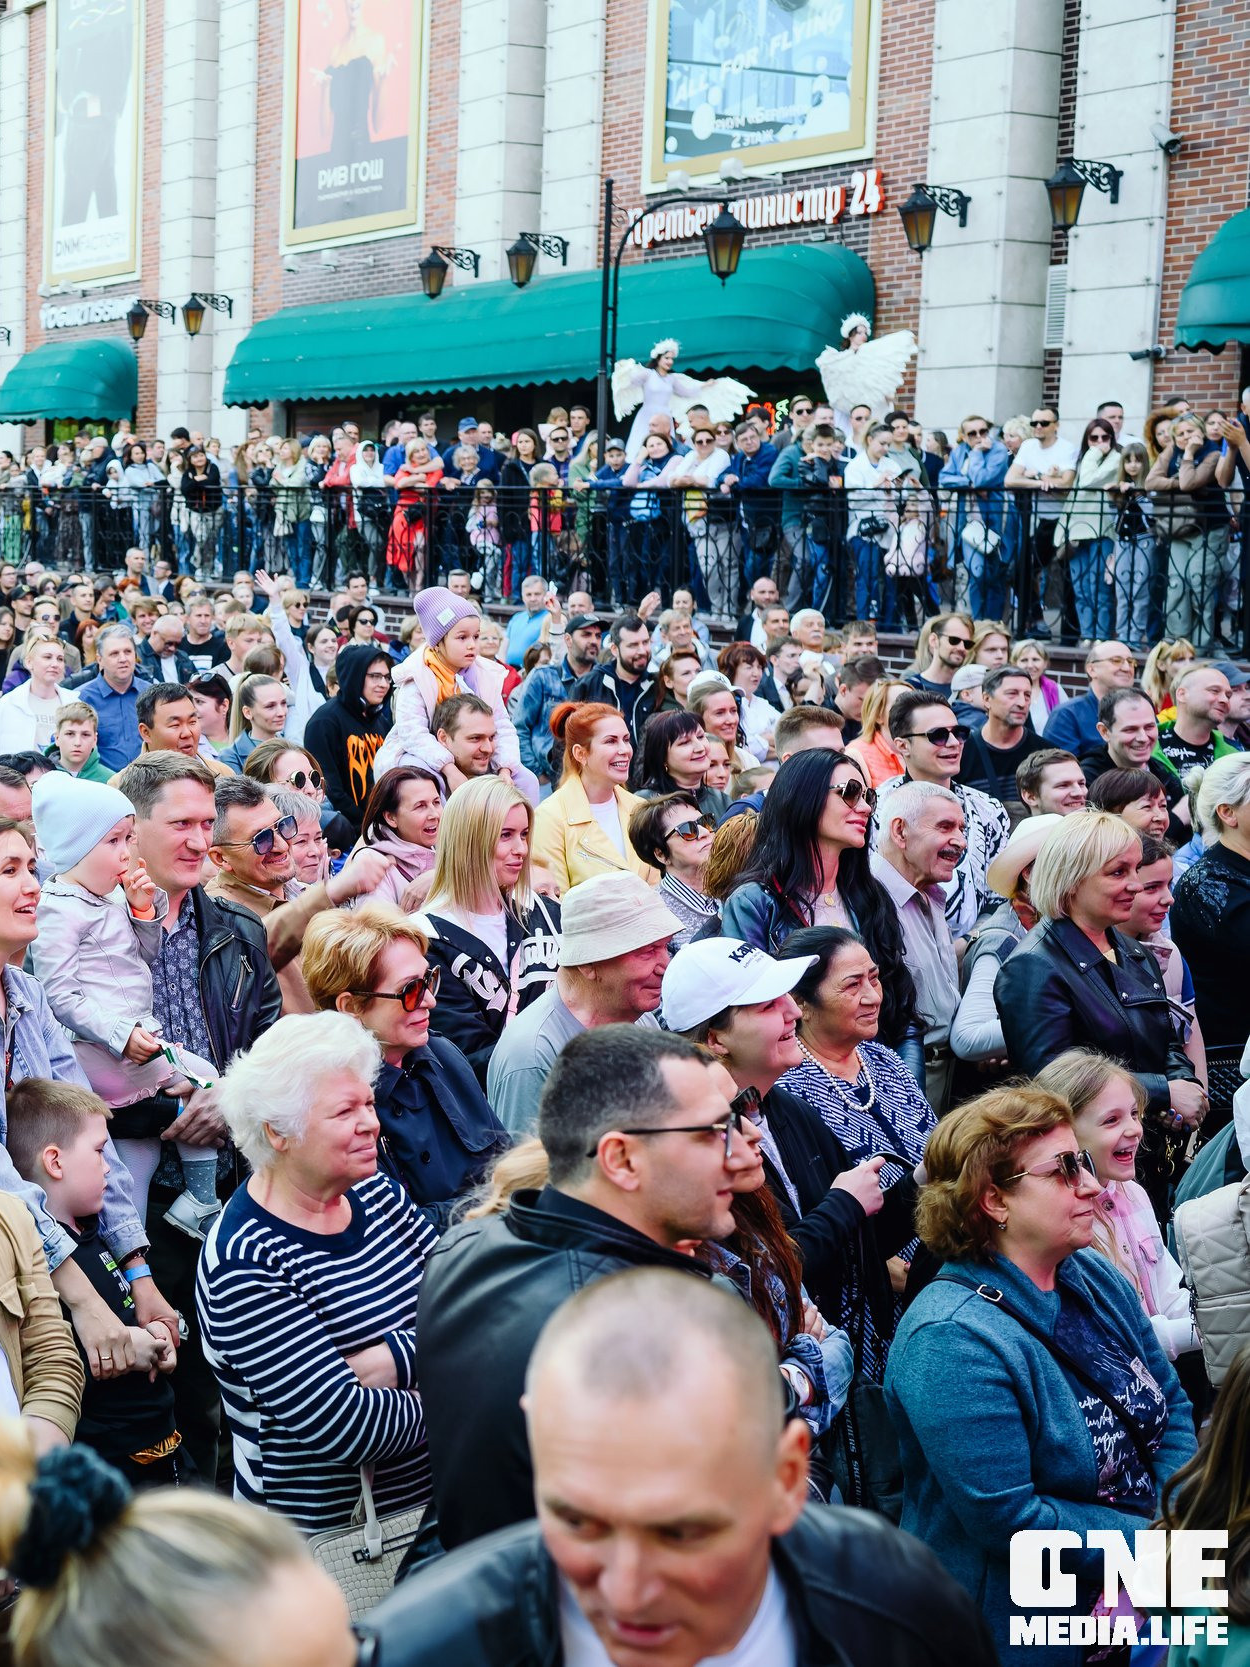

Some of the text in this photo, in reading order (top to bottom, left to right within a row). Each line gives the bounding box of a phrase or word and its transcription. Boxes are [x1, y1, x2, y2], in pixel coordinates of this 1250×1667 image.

[720, 47, 761, 83] FOR
[317, 158, 384, 190] РИВ ГОШ
[850, 169, 886, 216] 24
